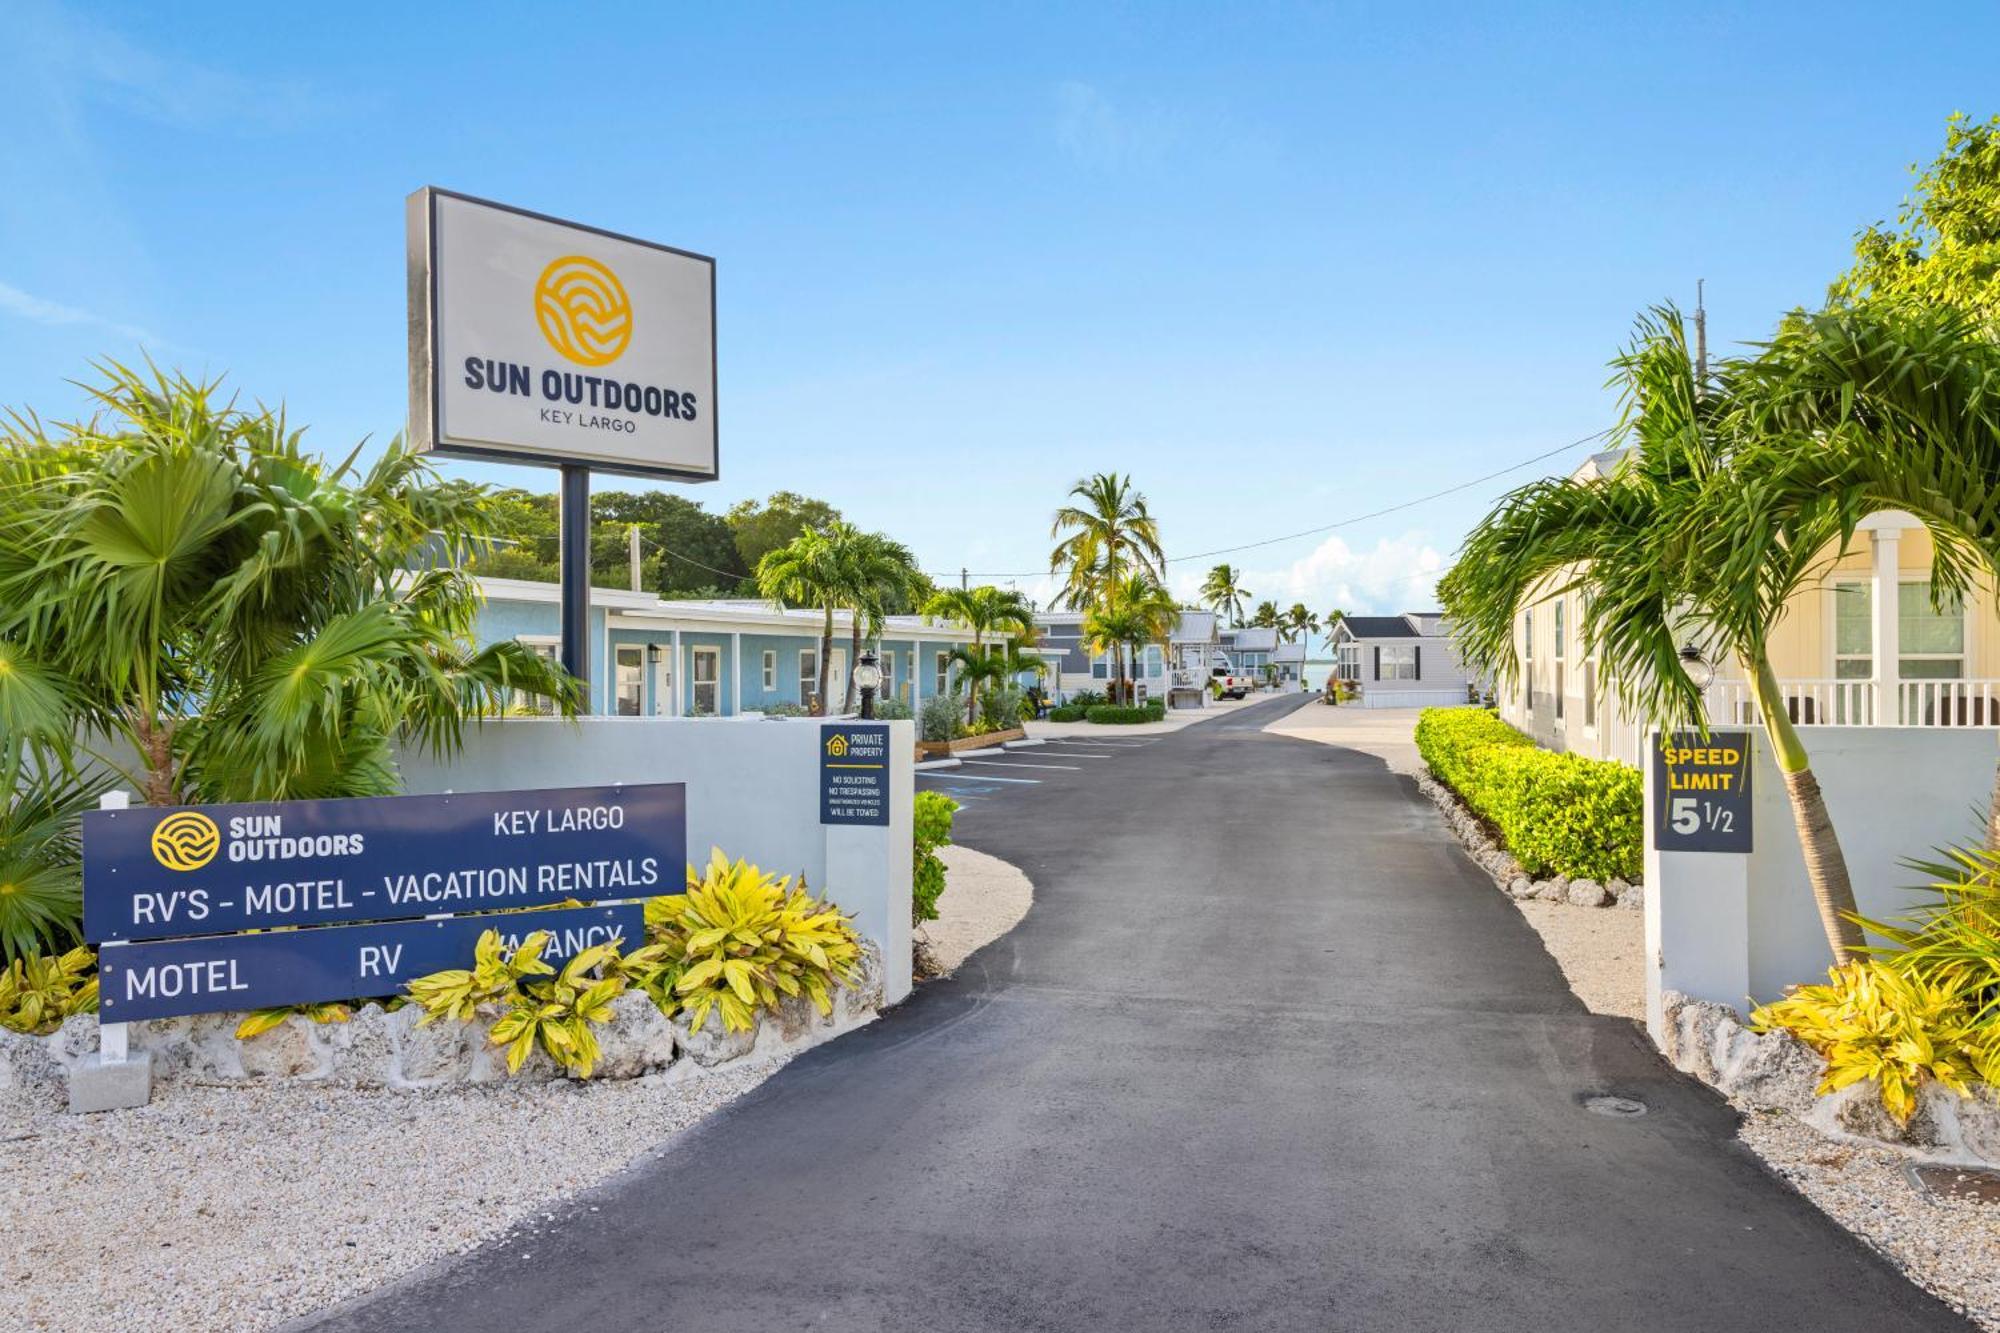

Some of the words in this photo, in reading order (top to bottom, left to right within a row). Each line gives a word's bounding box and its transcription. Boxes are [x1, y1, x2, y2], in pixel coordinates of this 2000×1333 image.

[464, 356, 531, 397] SUN
[542, 369, 697, 421] OUTDOORS
[540, 408, 573, 425] KEY
[579, 413, 636, 433] LARGO
[850, 734, 883, 745] PRIVATE
[850, 747, 883, 757] PROPERTY
[1664, 748, 1740, 765] SPEED
[829, 787, 838, 795] NO
[839, 787, 881, 796] TRESPASSING
[832, 776, 842, 784] NO
[843, 776, 877, 785] SOLICITING
[1670, 773, 1734, 790] LIMIT
[493, 810, 540, 836] KEY
[547, 805, 624, 833] LARGO
[831, 807, 845, 817] WILL
[846, 808, 855, 816] BE
[856, 808, 880, 817] TOWED
[1672, 798, 1700, 835] 5
[229, 815, 282, 839] SUN
[228, 834, 364, 862] OUTDOORS
[133, 889, 209, 924] RV'S
[245, 879, 353, 915] MOTEL
[383, 866, 528, 904] VACATION
[537, 858, 659, 893] RENTALS
[126, 959, 249, 1000] MOTEL
[360, 944, 403, 977] RV
[499, 924, 623, 963] AANCY
